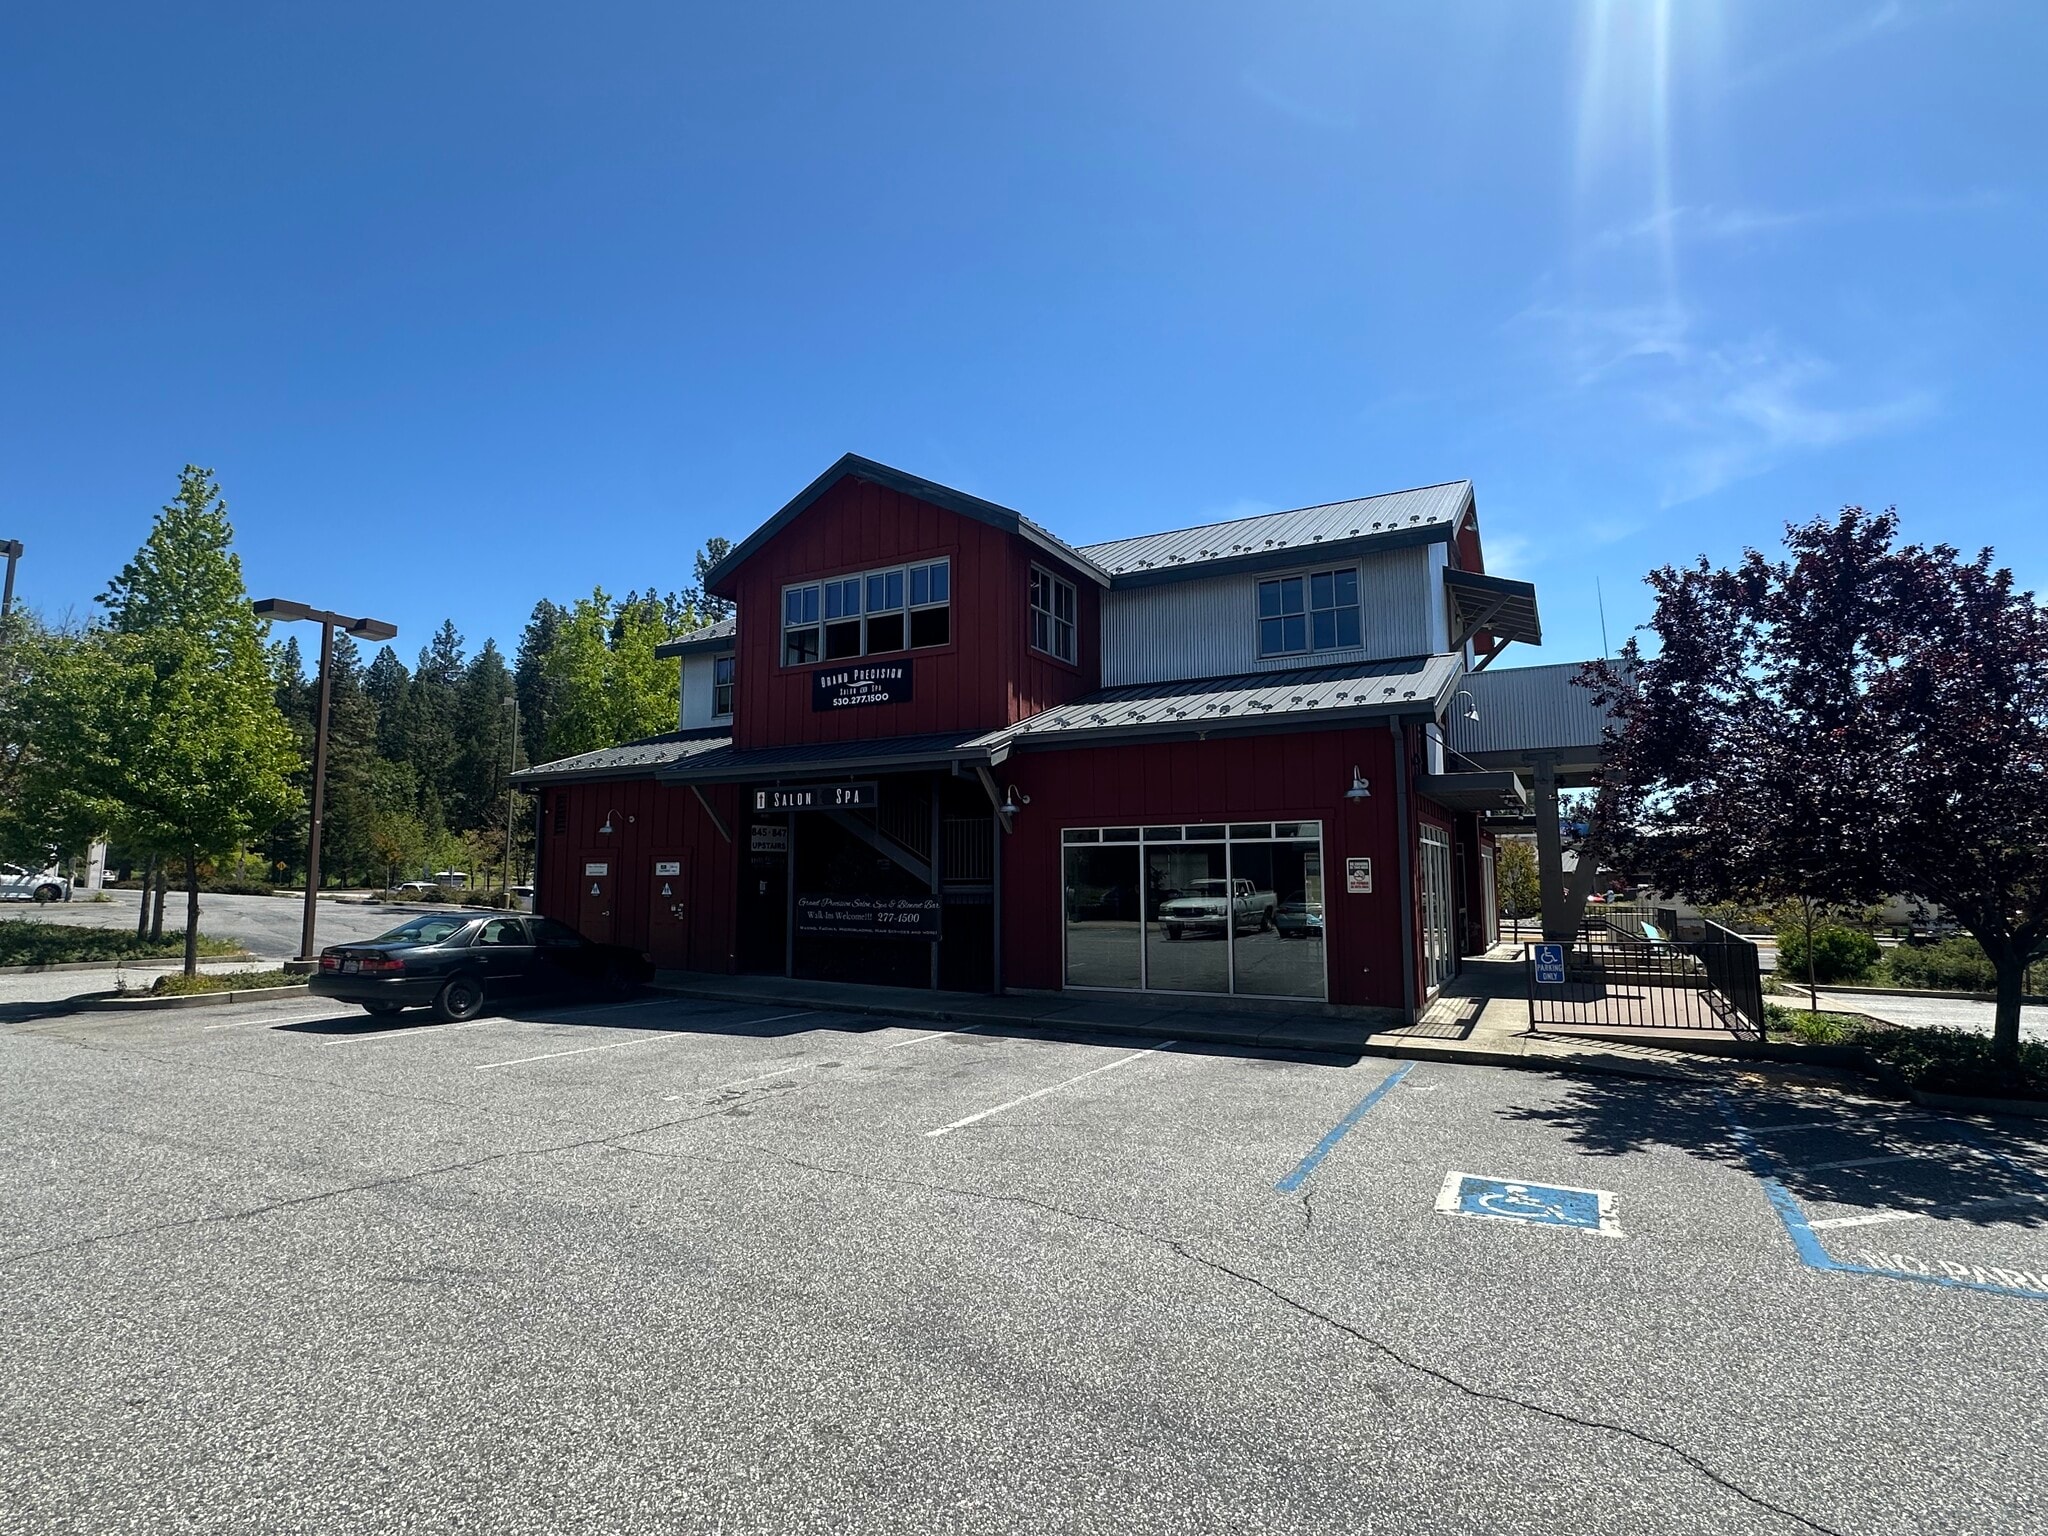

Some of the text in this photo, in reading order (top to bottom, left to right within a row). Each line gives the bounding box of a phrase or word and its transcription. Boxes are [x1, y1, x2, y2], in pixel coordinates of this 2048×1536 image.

[821, 668, 902, 688] GRAND PRECISION
[833, 693, 889, 706] 530.277.1500
[774, 788, 859, 807] SALON SPA
[877, 912, 920, 923] 277-1500
[1537, 964, 1562, 972] PARKING
[1542, 972, 1558, 980] ONLY
